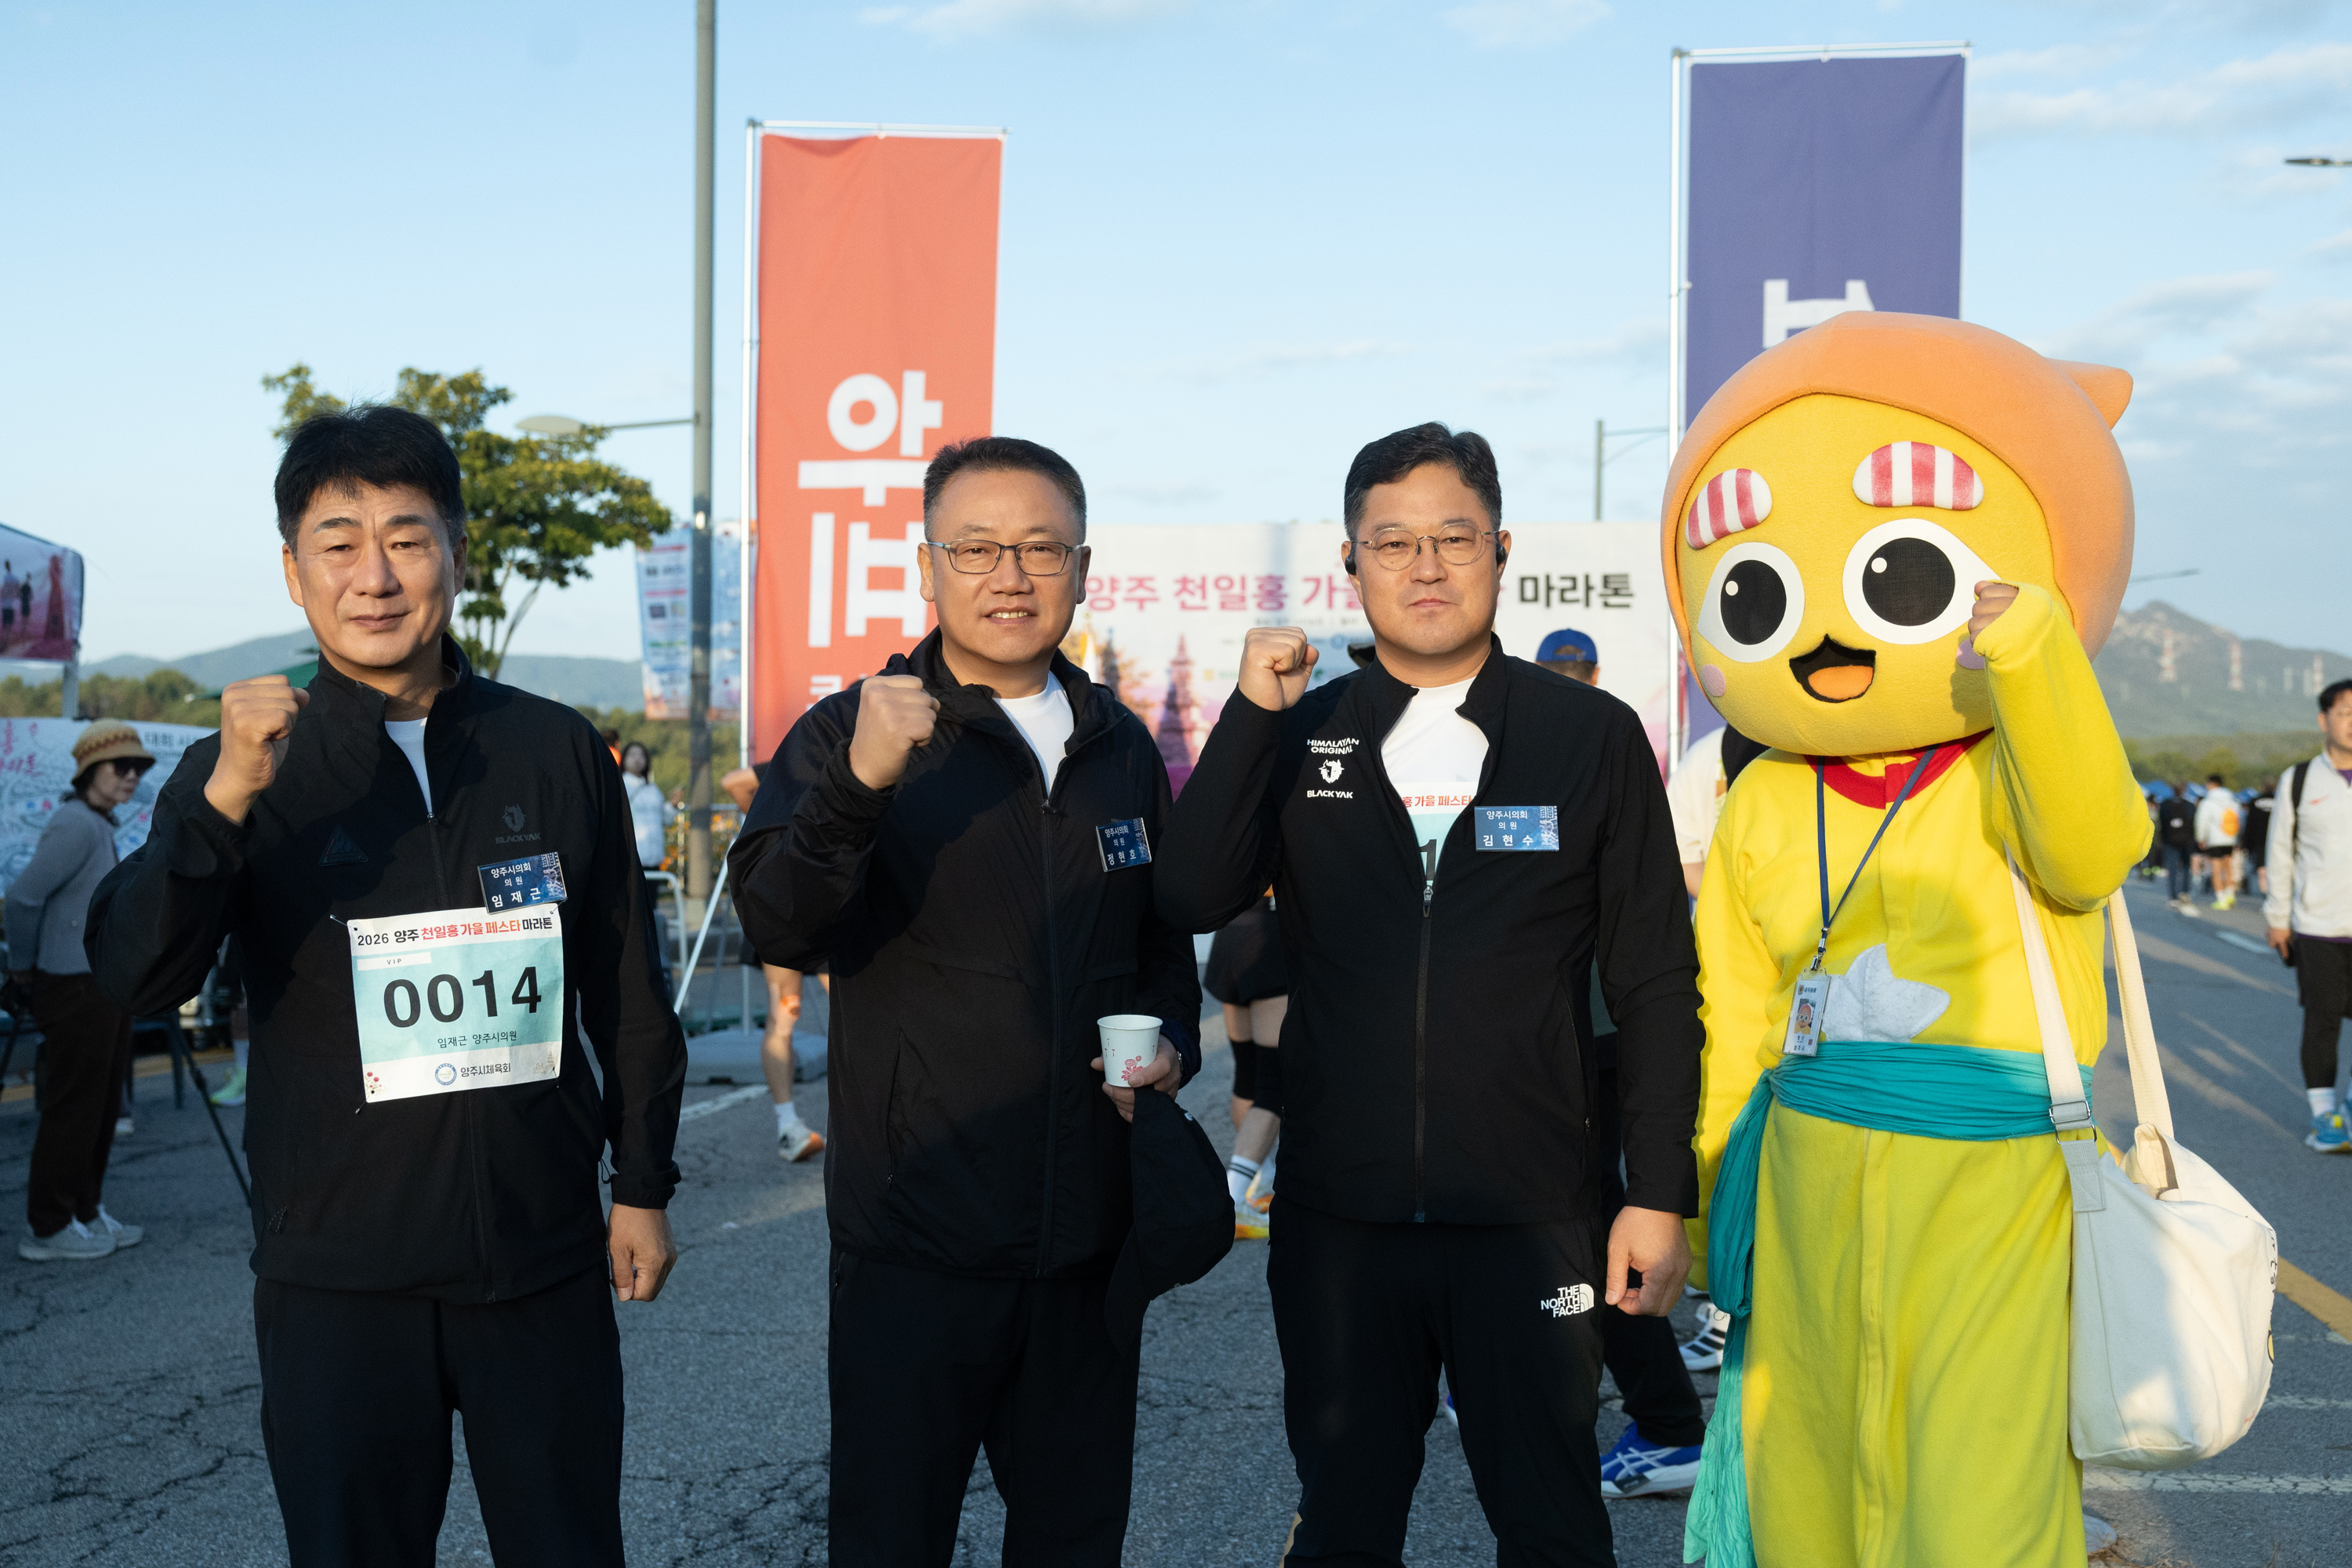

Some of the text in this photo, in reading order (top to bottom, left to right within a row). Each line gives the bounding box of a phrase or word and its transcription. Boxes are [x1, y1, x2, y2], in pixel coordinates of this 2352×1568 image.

[1086, 575, 1160, 612] 양주
[1174, 573, 1287, 612] 천일홍
[1519, 573, 1634, 610] 마라톤
[1307, 737, 1359, 747] HIMALAYAN
[1310, 745, 1353, 755] ORIGINAL
[1414, 795, 1436, 807] 가을
[1438, 794, 1473, 806] 페스타
[1486, 811, 1528, 820] 양주시의회
[1105, 825, 1129, 838] 양주시의회
[491, 862, 532, 879] 양주시의회
[358, 916, 553, 946] 2026 양주 천일홍 가을 페스타 마라톤
[383, 966, 542, 1029] 0014
[437, 1030, 517, 1048] 임재근 양주시의원
[460, 1062, 511, 1078] 양주시체육회
[1557, 1285, 1579, 1298] THE
[1541, 1294, 1580, 1310] NORTH
[1552, 1304, 1581, 1318] FACE
